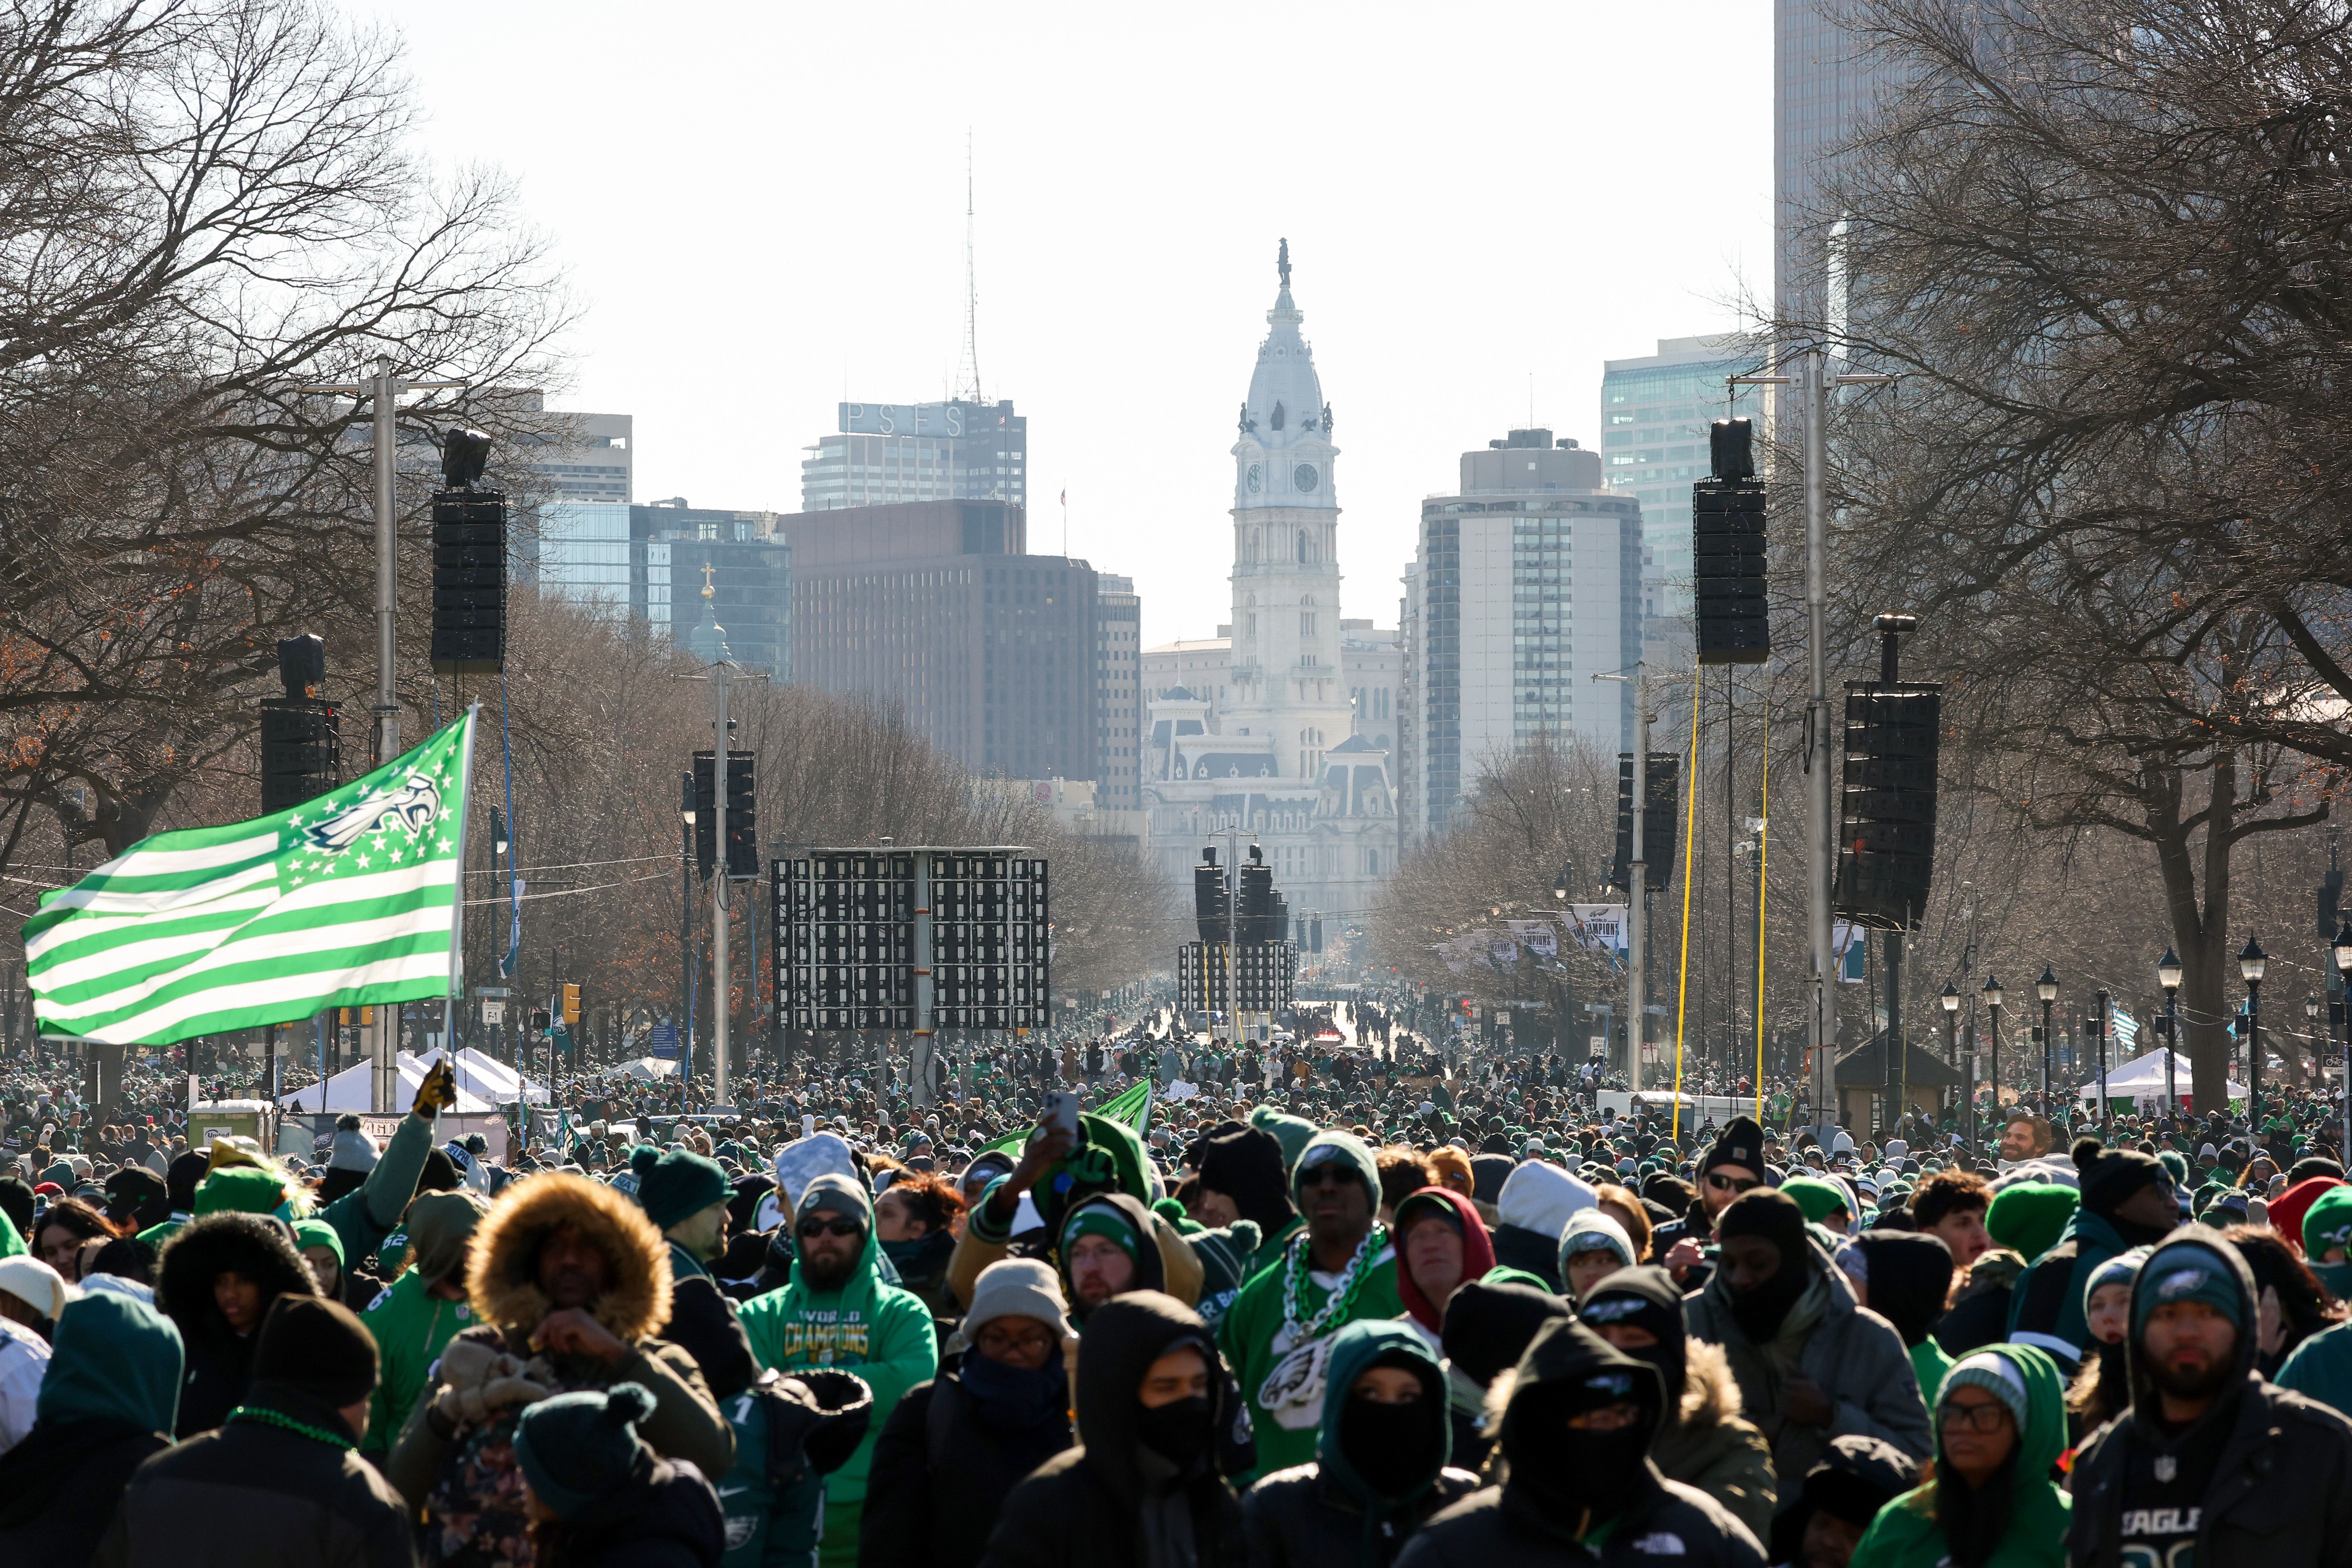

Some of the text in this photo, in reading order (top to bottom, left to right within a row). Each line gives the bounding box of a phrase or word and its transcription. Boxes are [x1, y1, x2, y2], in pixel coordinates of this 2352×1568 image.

[847, 403, 961, 437] PSFS
[488, 1012, 497, 1021] F-1
[367, 1288, 393, 1312] 6
[784, 1322, 870, 1357] CHAMPONS
